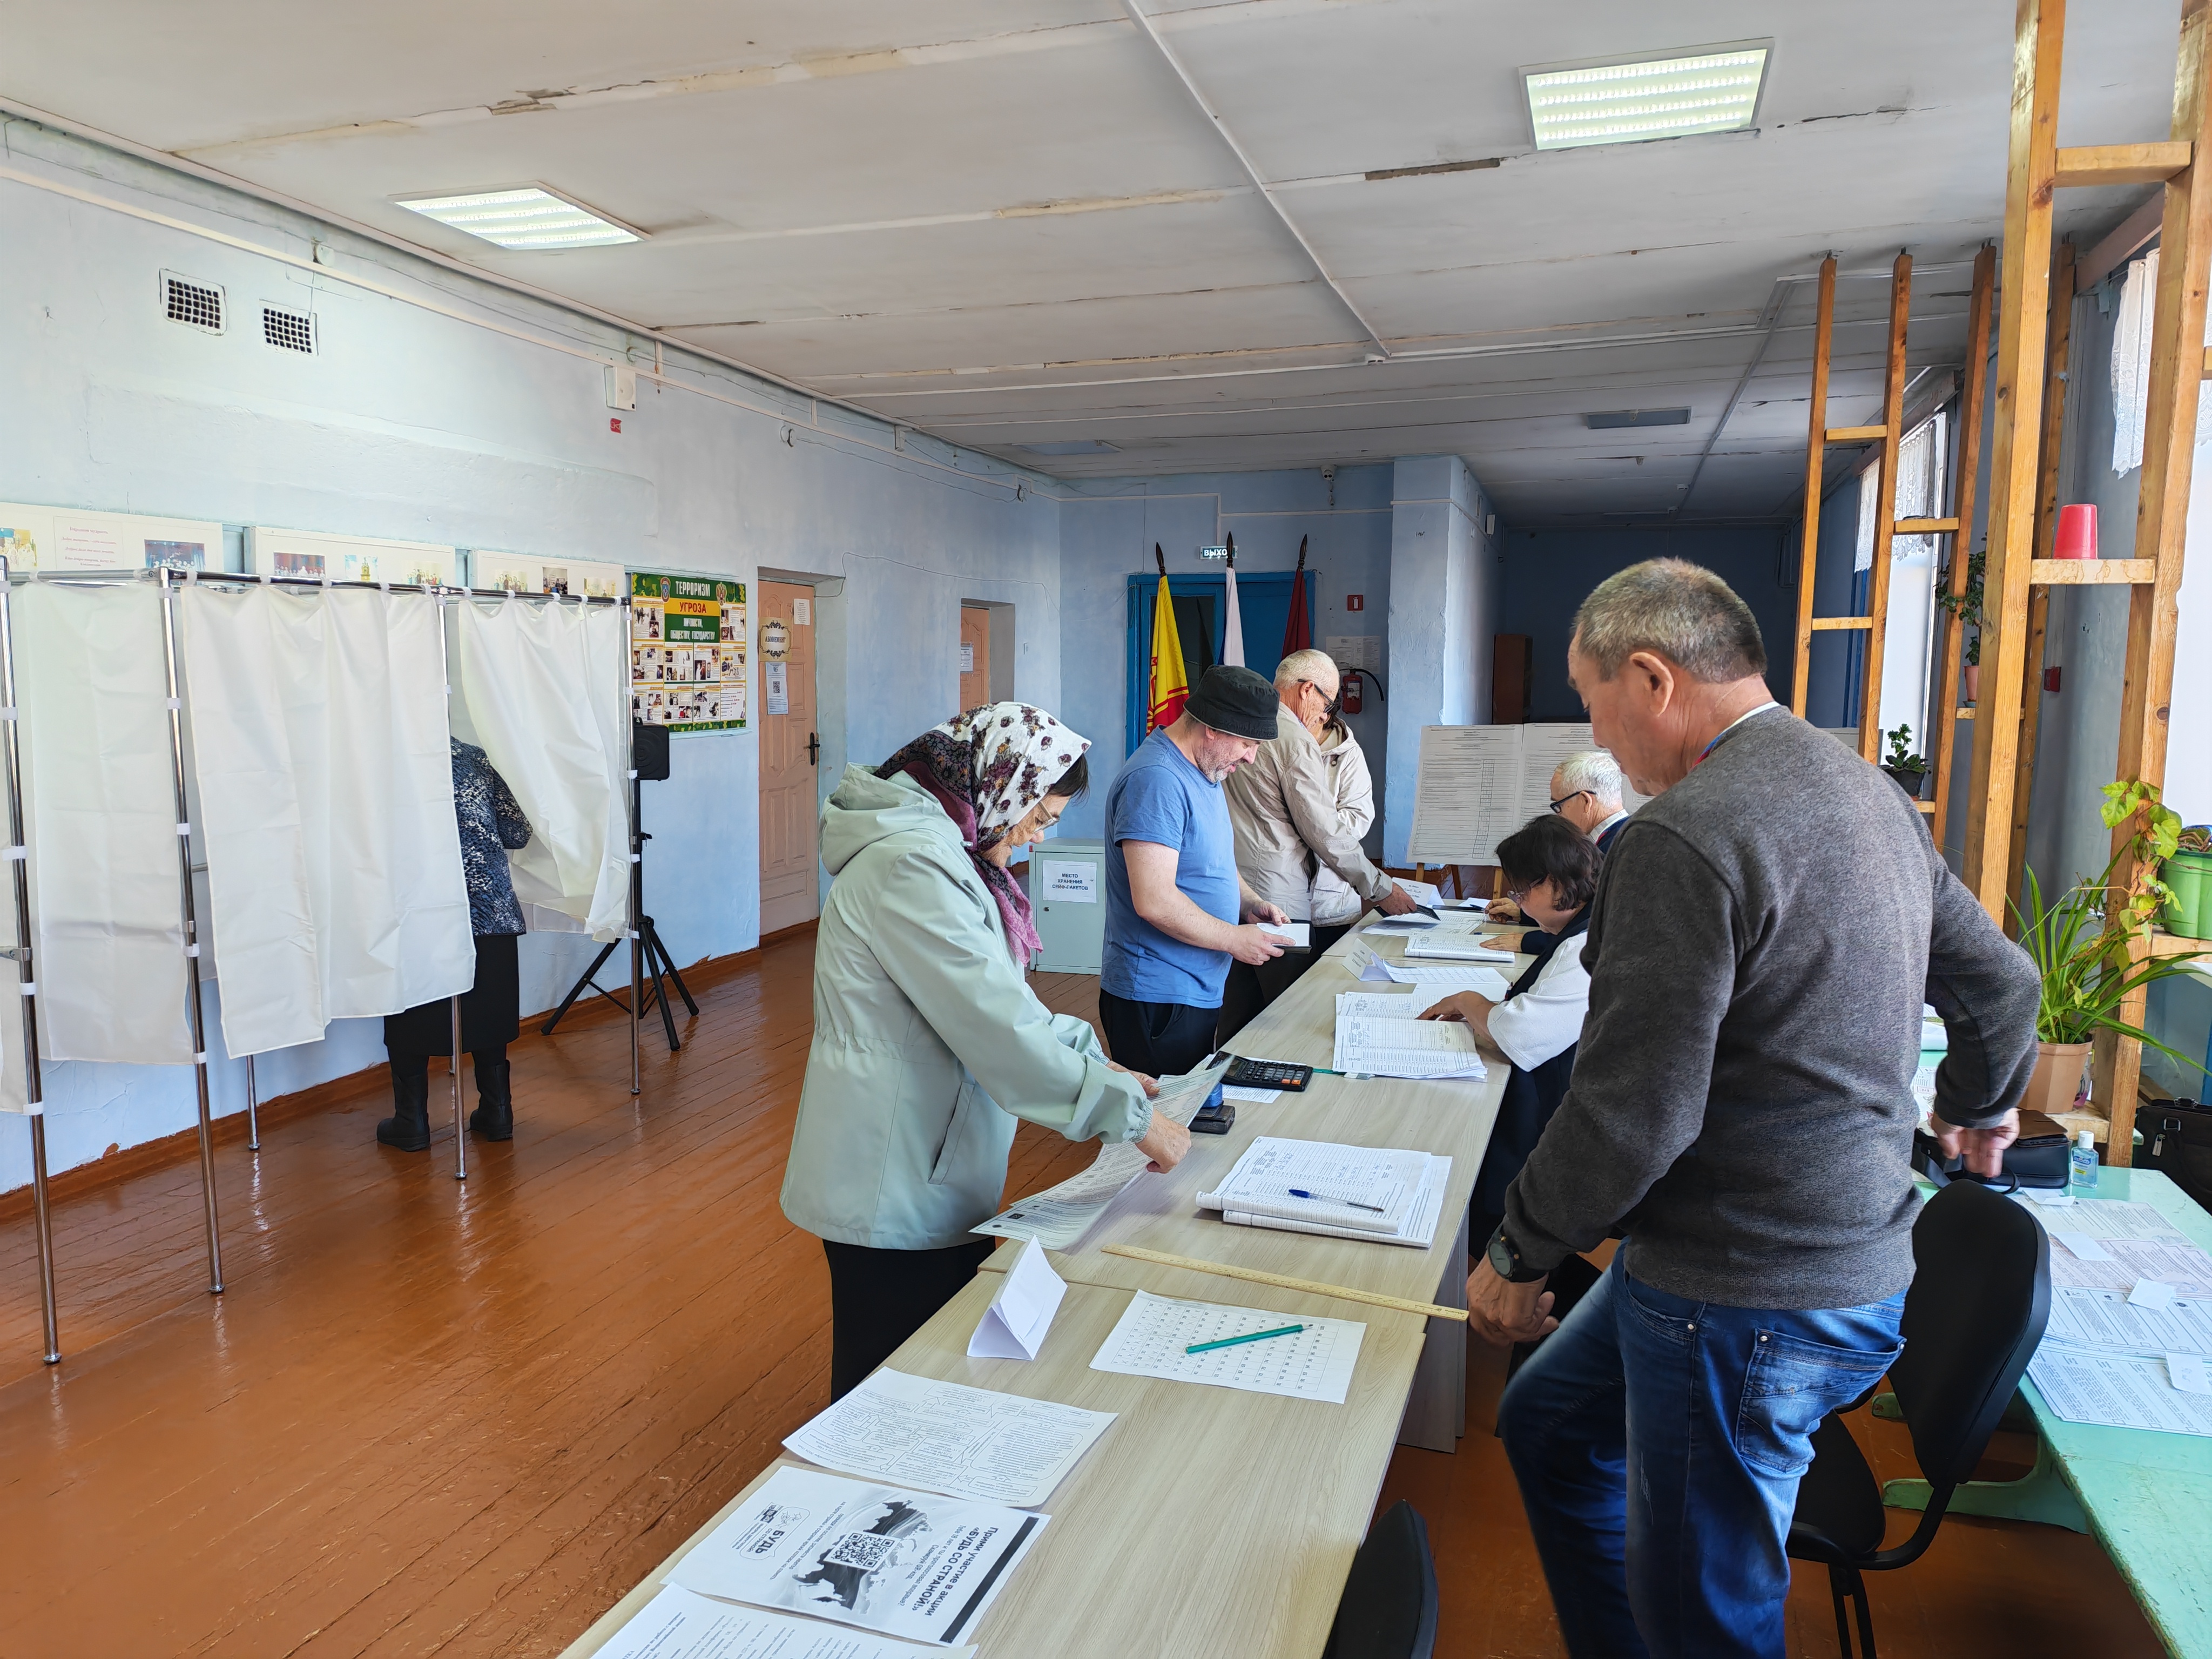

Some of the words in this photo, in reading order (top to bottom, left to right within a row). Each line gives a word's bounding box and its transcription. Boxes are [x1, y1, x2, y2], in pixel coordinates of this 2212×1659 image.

[675, 581, 710, 597] ТЕРРОРИЗМ
[679, 602, 706, 613] УГРОЗА
[670, 630, 691, 640] ОБЩЕСТВУ,
[692, 631, 715, 640] ГОСУДАРСТВУ
[954, 1525, 966, 1534] Тебе
[957, 1527, 979, 1550] «БУДЬ
[974, 1527, 998, 1551] Прими
[746, 1534, 767, 1552] СТРАНОЙ!
[755, 1530, 785, 1554] БУДЬ
[948, 1552, 962, 1563] СО
[949, 1552, 977, 1583] участие
[915, 1555, 940, 1584] проголосовал
[898, 1584, 918, 1606] впервые?
[912, 1565, 952, 1610] СТРАНОЙ!»
[925, 1591, 948, 1616] акции
